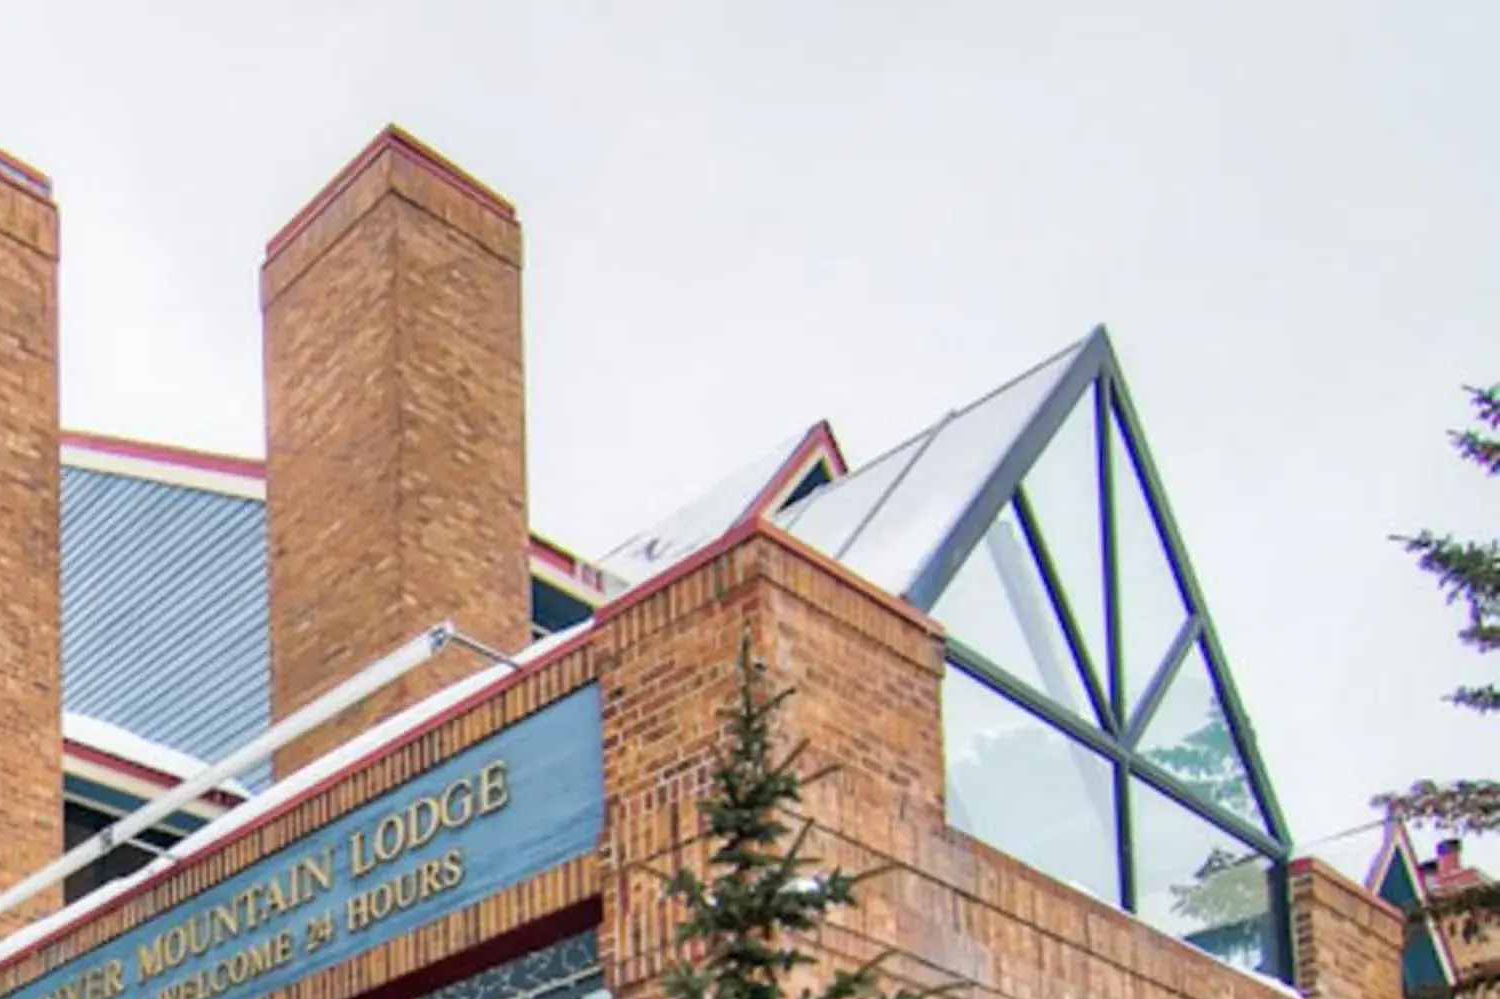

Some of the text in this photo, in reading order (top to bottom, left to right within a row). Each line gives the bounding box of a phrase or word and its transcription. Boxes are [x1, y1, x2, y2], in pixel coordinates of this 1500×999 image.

[136, 845, 334, 984] MOUNTAIN
[350, 759, 510, 878] LODGE
[305, 909, 334, 951] 24
[347, 849, 463, 931] HOURS
